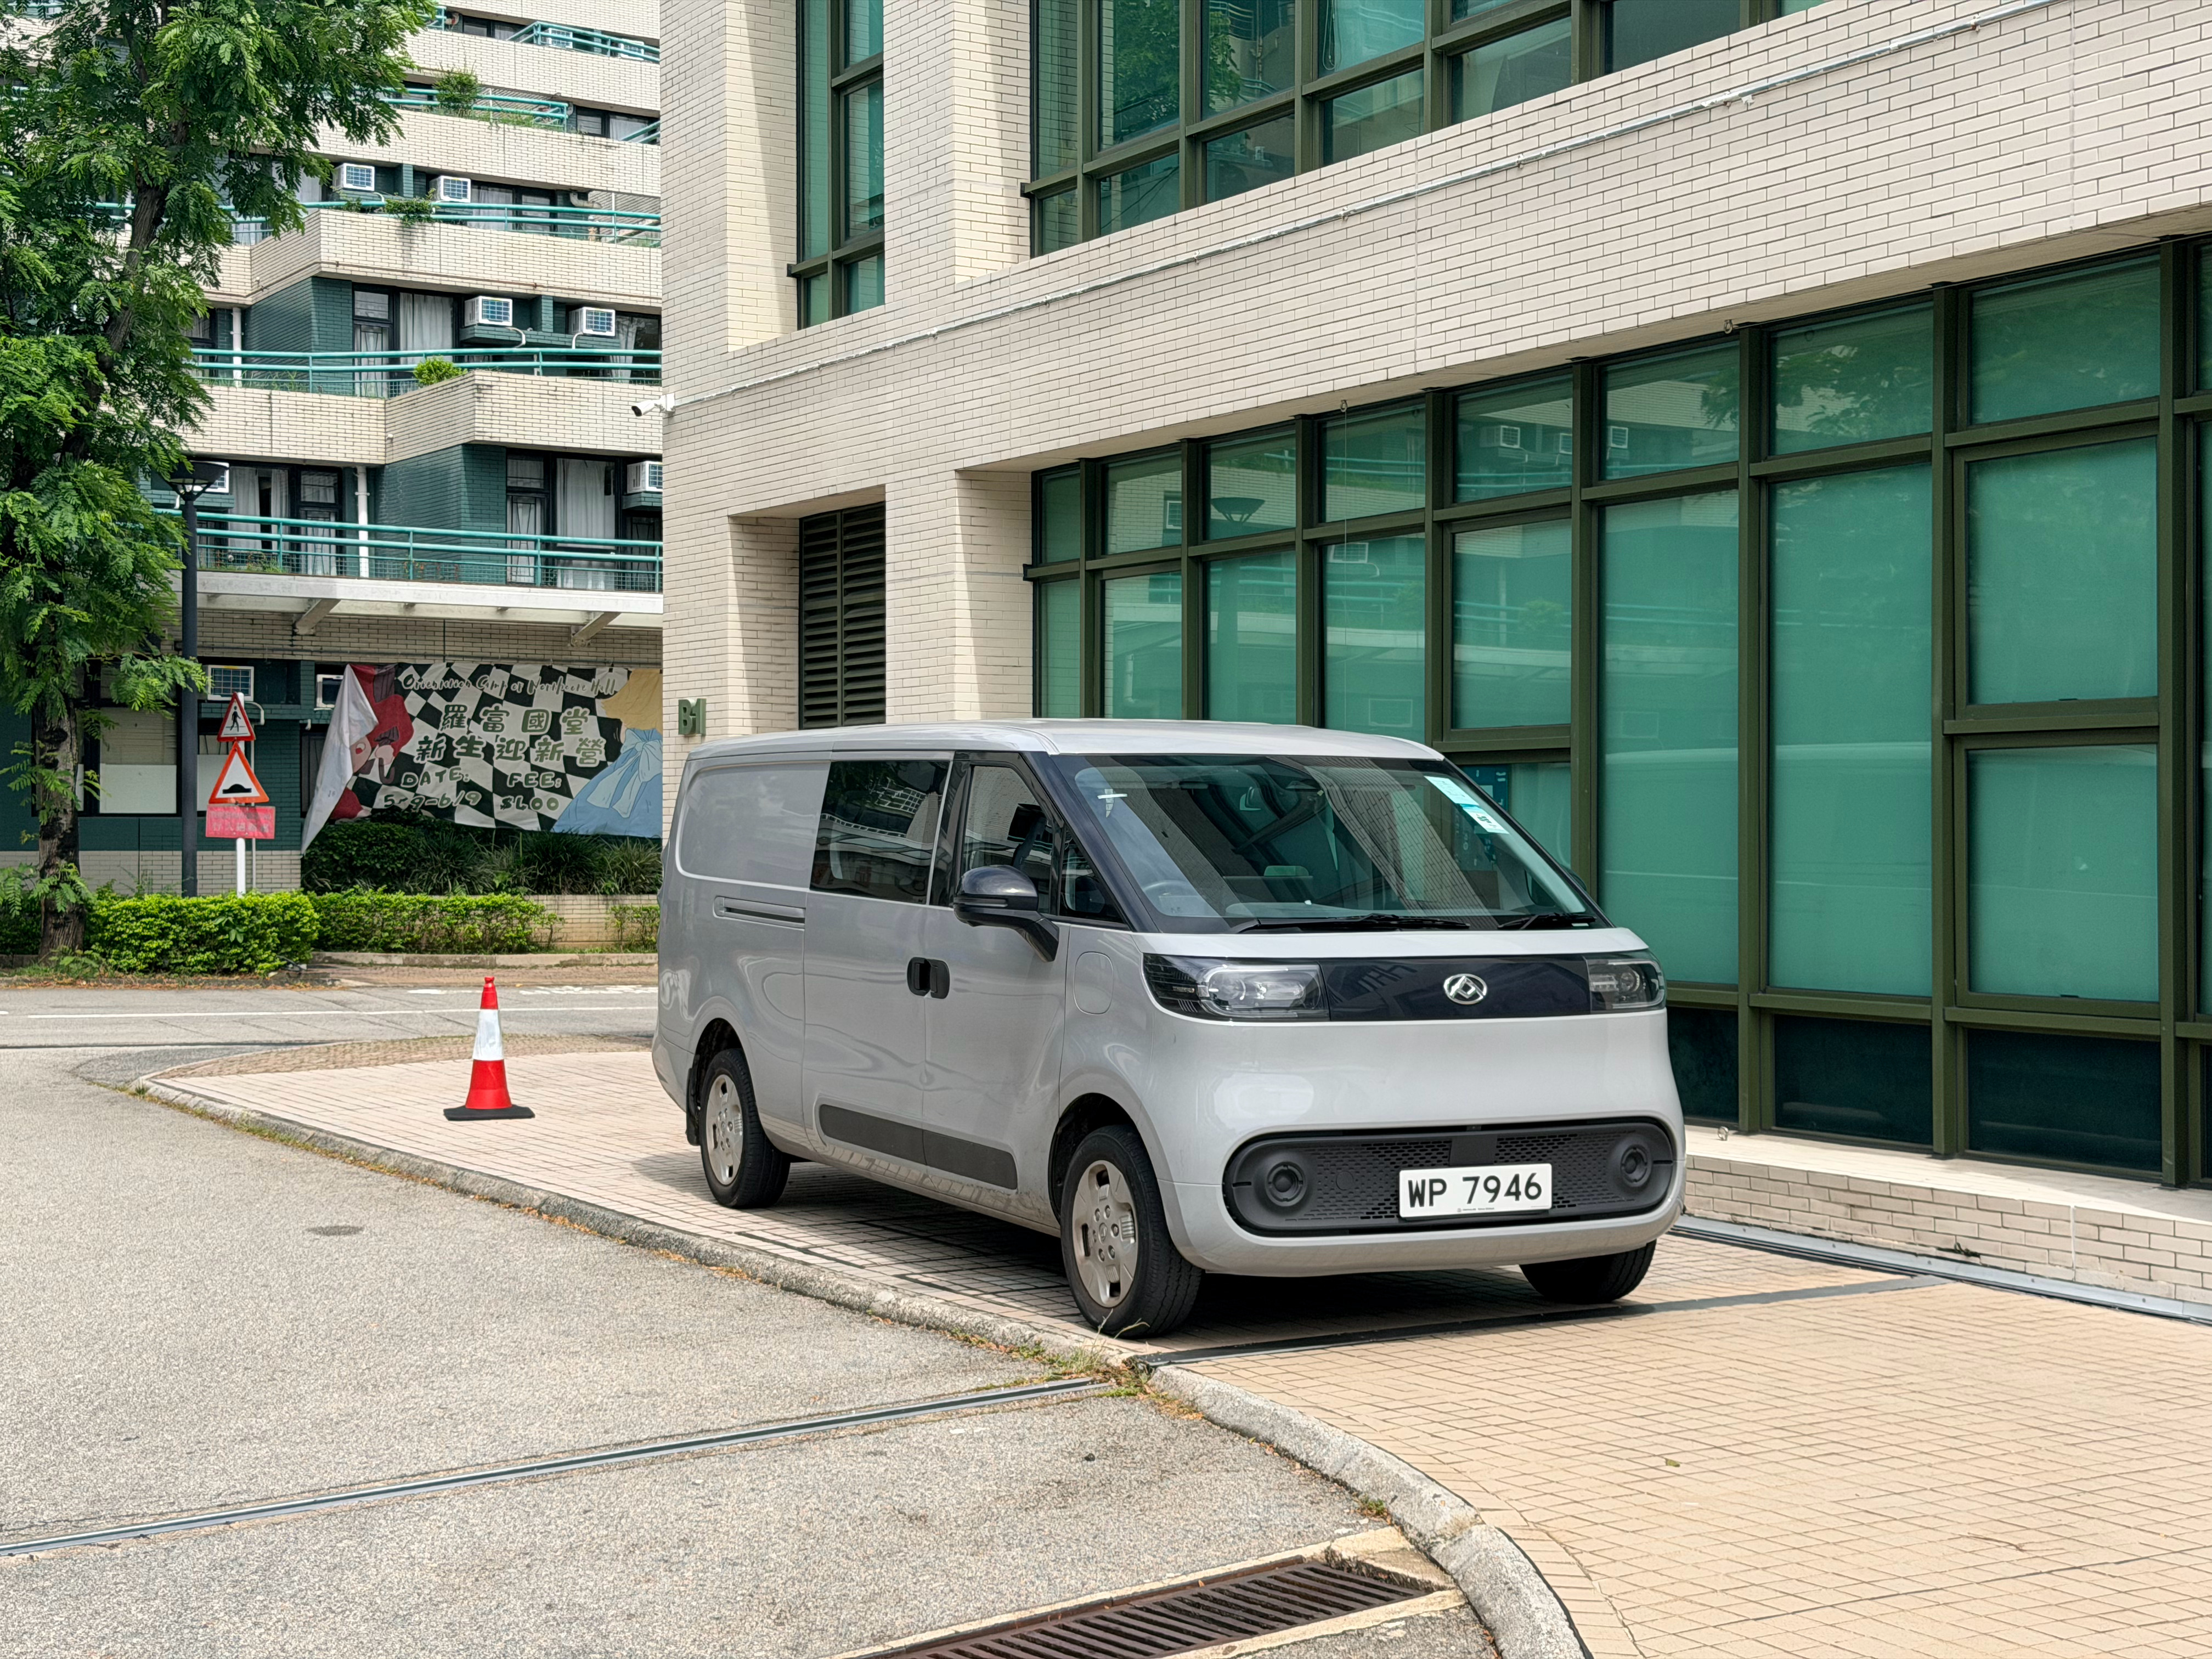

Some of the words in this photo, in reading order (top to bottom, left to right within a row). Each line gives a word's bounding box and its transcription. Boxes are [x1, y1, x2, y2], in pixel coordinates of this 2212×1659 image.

[476, 675, 508, 697] Camp
[591, 678, 616, 695] Hall
[440, 704, 589, 735] 羅富國堂
[678, 698, 707, 735] B1
[415, 735, 603, 765] 新生迎新營
[402, 768, 469, 787] DATE:
[507, 772, 561, 787] FEE:
[1408, 1178, 1447, 1207] WP
[1462, 1172, 1542, 1204] 7946
